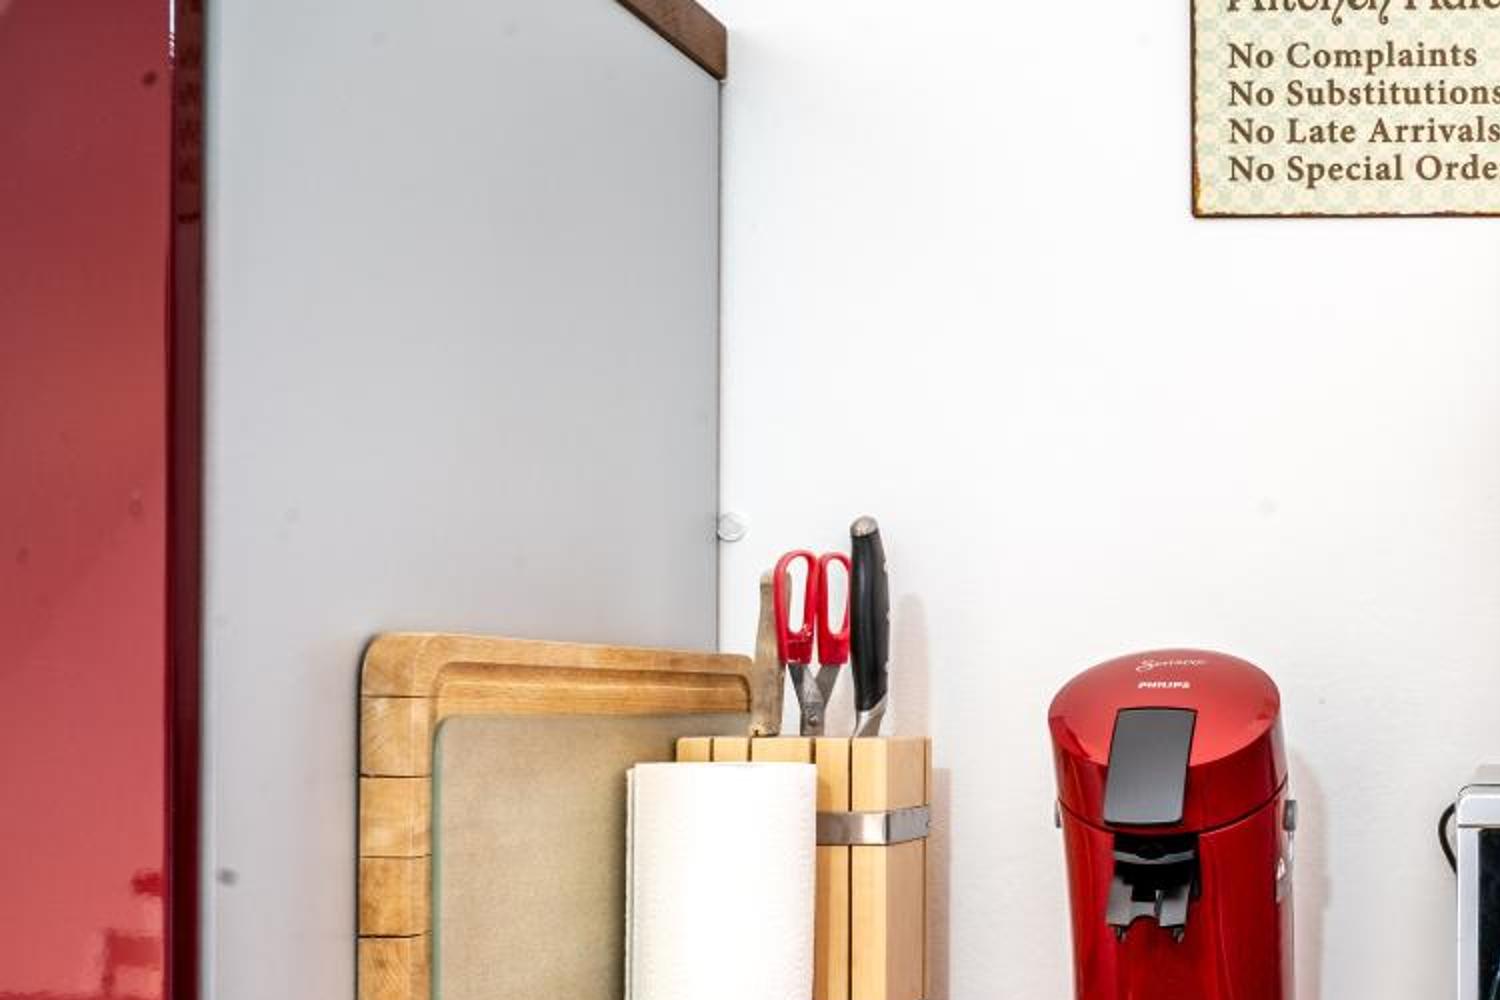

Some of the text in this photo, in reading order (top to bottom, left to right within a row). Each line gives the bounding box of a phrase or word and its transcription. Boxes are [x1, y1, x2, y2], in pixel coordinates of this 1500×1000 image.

[1228, 41, 1477, 75] No Complaints
[1228, 80, 1274, 106] No
[1228, 116, 1500, 144] No Late Arrivals
[1228, 155, 1274, 182] No
[1287, 154, 1404, 189] Special
